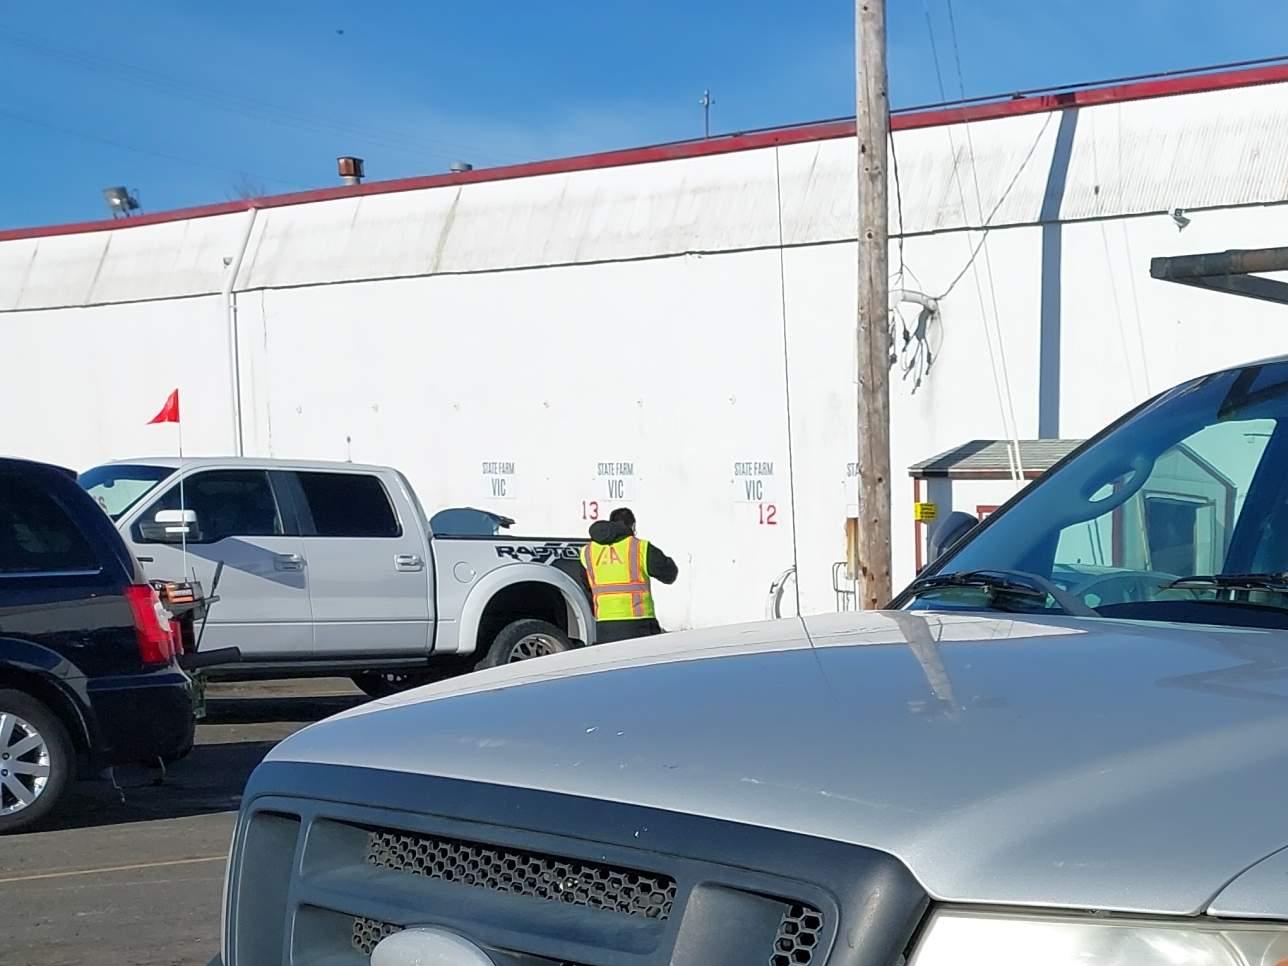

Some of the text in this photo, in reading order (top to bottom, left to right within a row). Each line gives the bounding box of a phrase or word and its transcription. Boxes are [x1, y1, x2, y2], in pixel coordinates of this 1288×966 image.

[482, 462, 516, 475] STATE FARM
[597, 462, 634, 476] STATE FARM
[734, 462, 774, 476] STATE FARM
[491, 478, 507, 497] VIC
[608, 479, 624, 499] VIC
[745, 479, 763, 501] VIC
[582, 500, 599, 520] 13
[758, 503, 777, 525] 12
